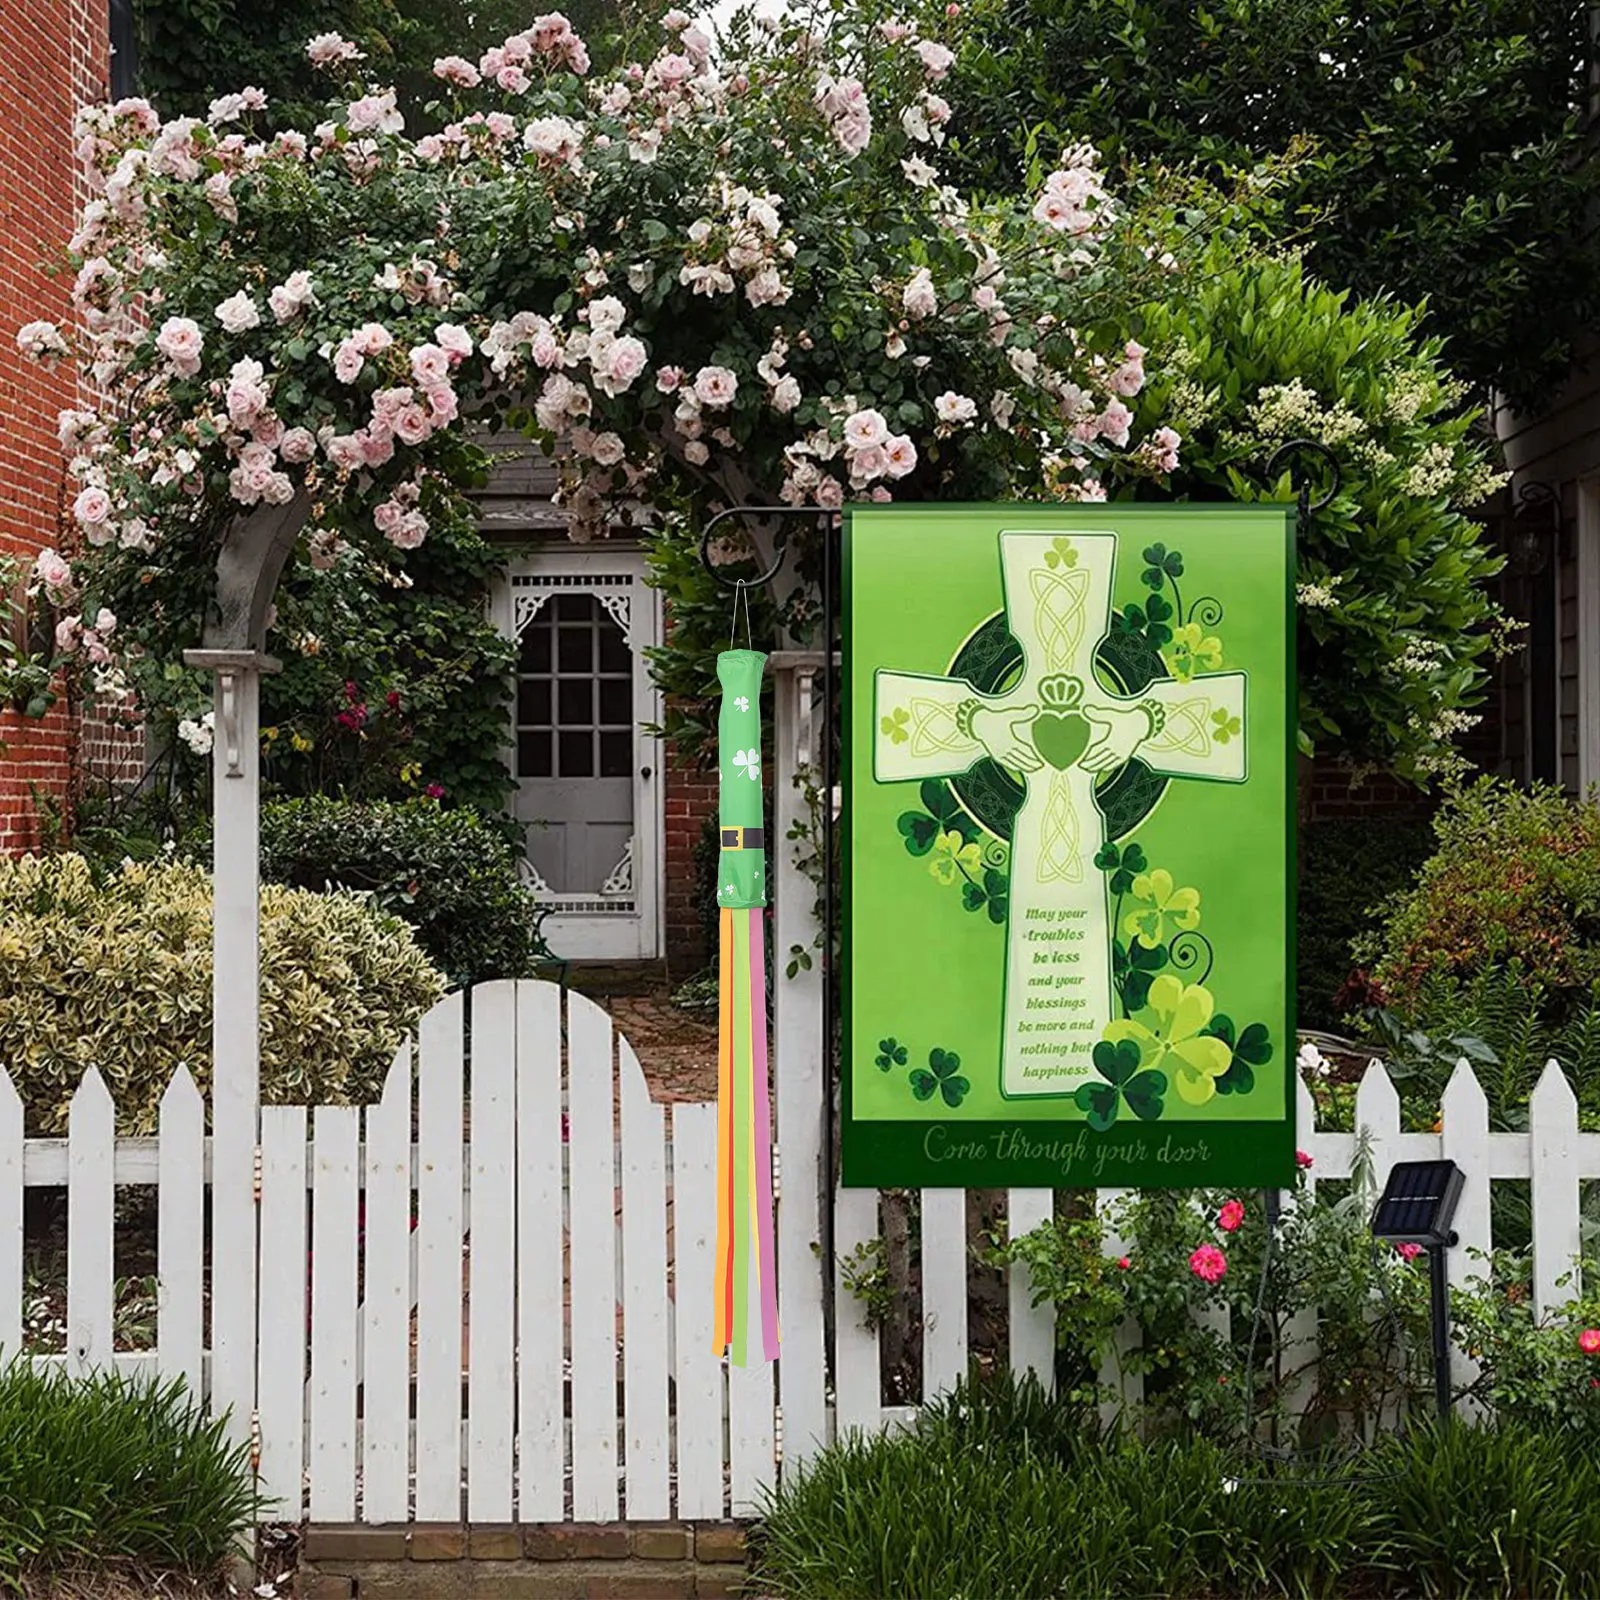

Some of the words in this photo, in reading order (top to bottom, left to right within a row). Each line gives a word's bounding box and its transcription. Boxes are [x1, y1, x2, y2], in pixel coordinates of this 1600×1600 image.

[1025, 907, 1056, 922] May
[1058, 908, 1088, 922] your
[1027, 929, 1085, 942] troubles
[1032, 952, 1048, 964] be
[1052, 951, 1080, 963] less
[1028, 975, 1053, 986] and
[1055, 975, 1085, 989] your
[1025, 997, 1087, 1011] blessings
[1018, 1020, 1033, 1032] be
[1035, 1021, 1066, 1031] more
[1069, 1019, 1095, 1030] and
[1020, 1043, 1068, 1056] nothing
[1071, 1041, 1093, 1053] but
[1022, 1065, 1089, 1080] happiness
[923, 1125, 987, 1162] Come
[989, 1128, 1089, 1176] through
[1095, 1141, 1150, 1177] your
[1156, 1134, 1211, 1163] door
